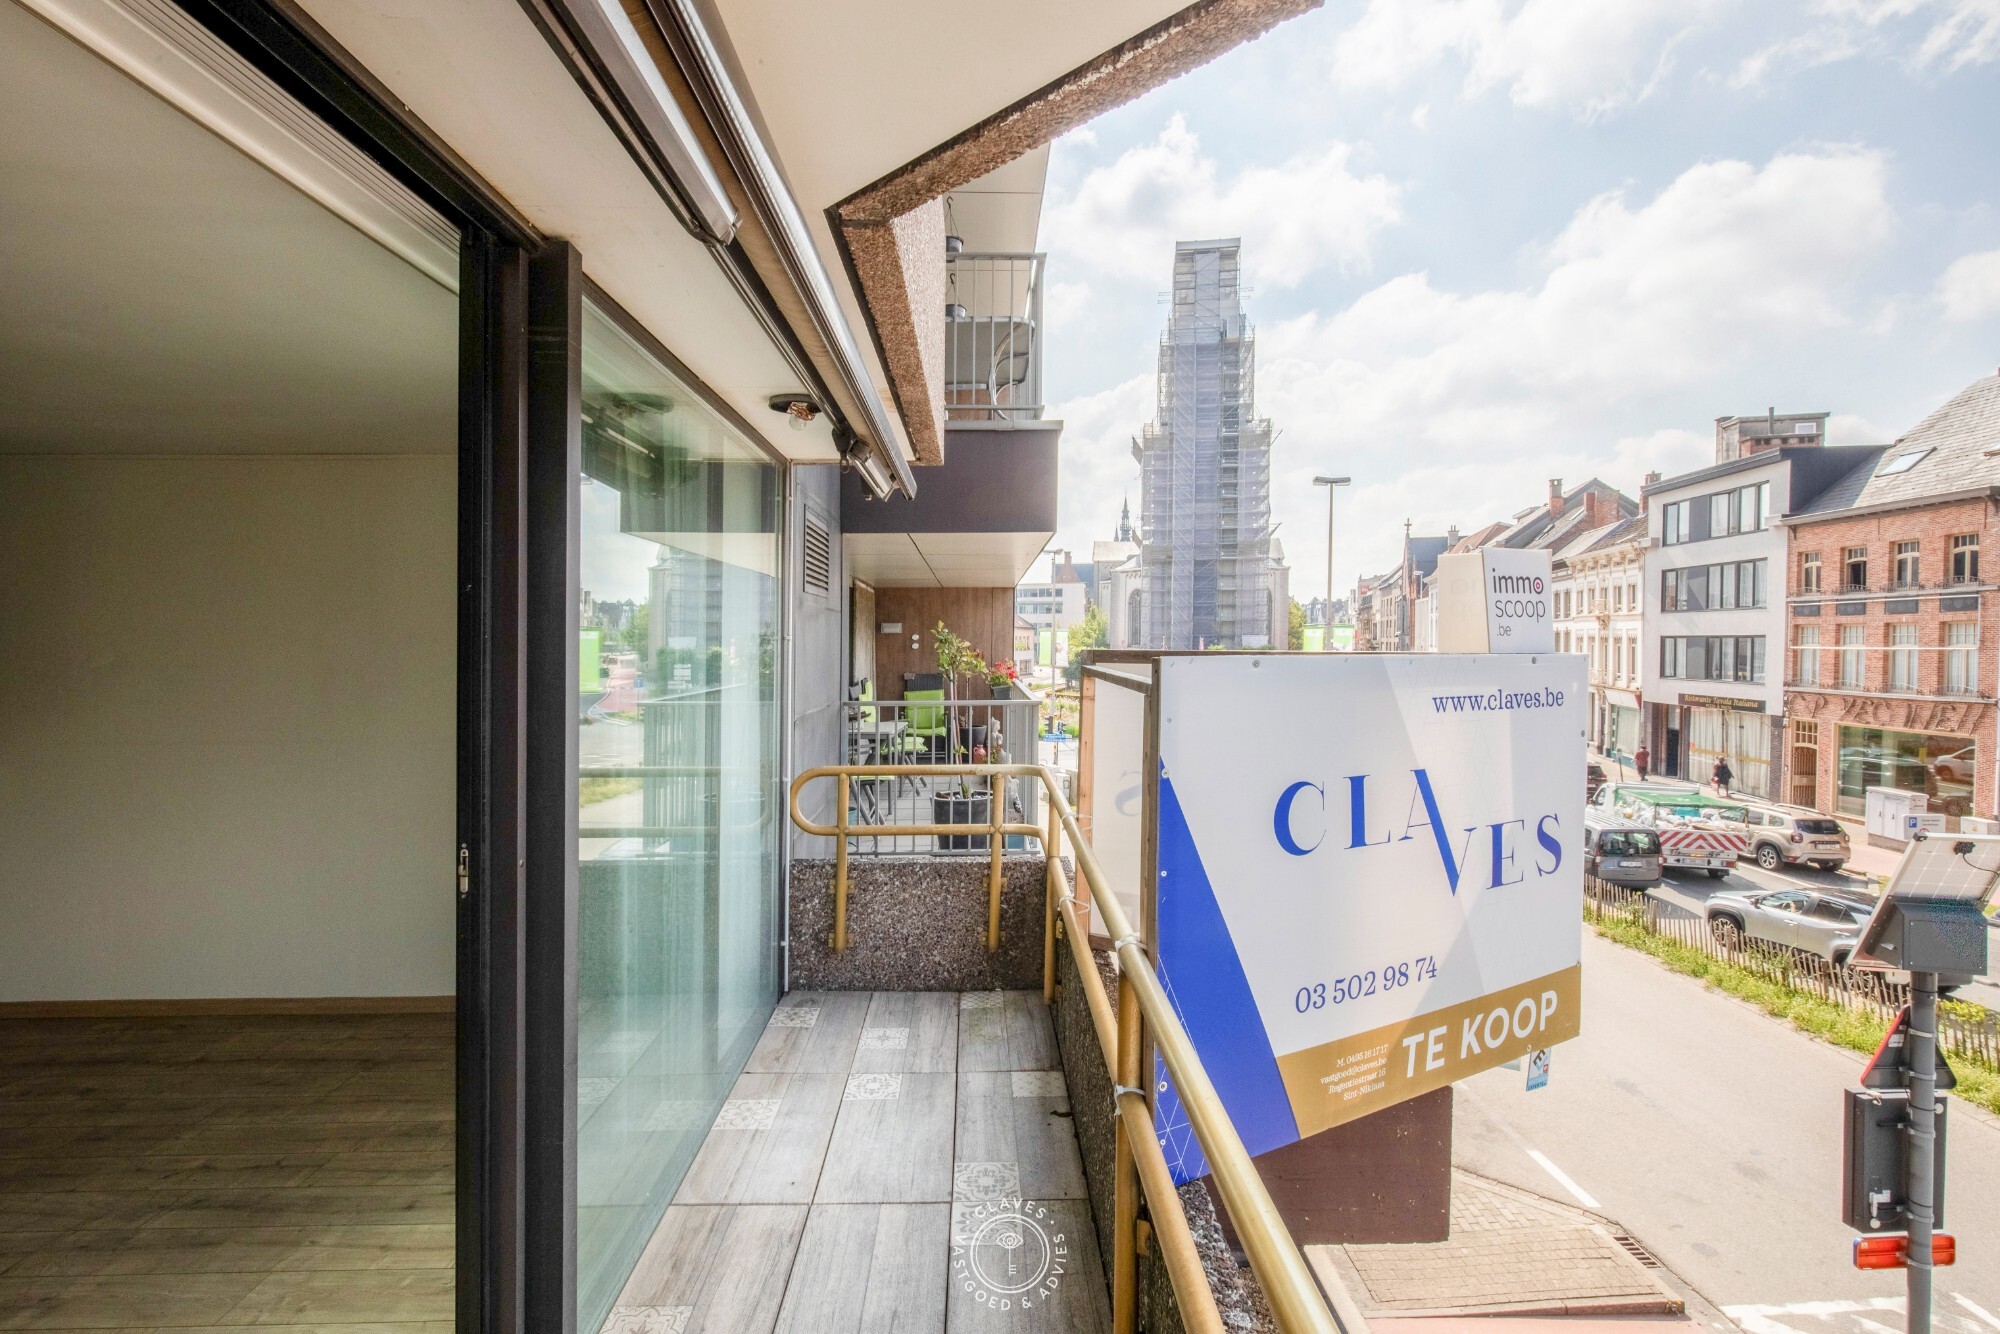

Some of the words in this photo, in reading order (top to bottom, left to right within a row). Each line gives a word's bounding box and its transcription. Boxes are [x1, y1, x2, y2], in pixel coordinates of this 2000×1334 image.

[1492, 568, 1544, 595] immo
[1495, 600, 1546, 623] scoop
[1496, 623, 1512, 636] .be
[1432, 687, 1564, 713] www.claves.be
[1274, 768, 1562, 897] CLAVES
[1295, 983, 1326, 1014] 03
[1332, 971, 1376, 1004] 502
[1383, 963, 1409, 991] 98
[1415, 956, 1438, 982] 74
[1402, 1025, 1447, 1078] TE
[1460, 990, 1558, 1059] KOOP
[1336, 1058, 1346, 1068] M.
